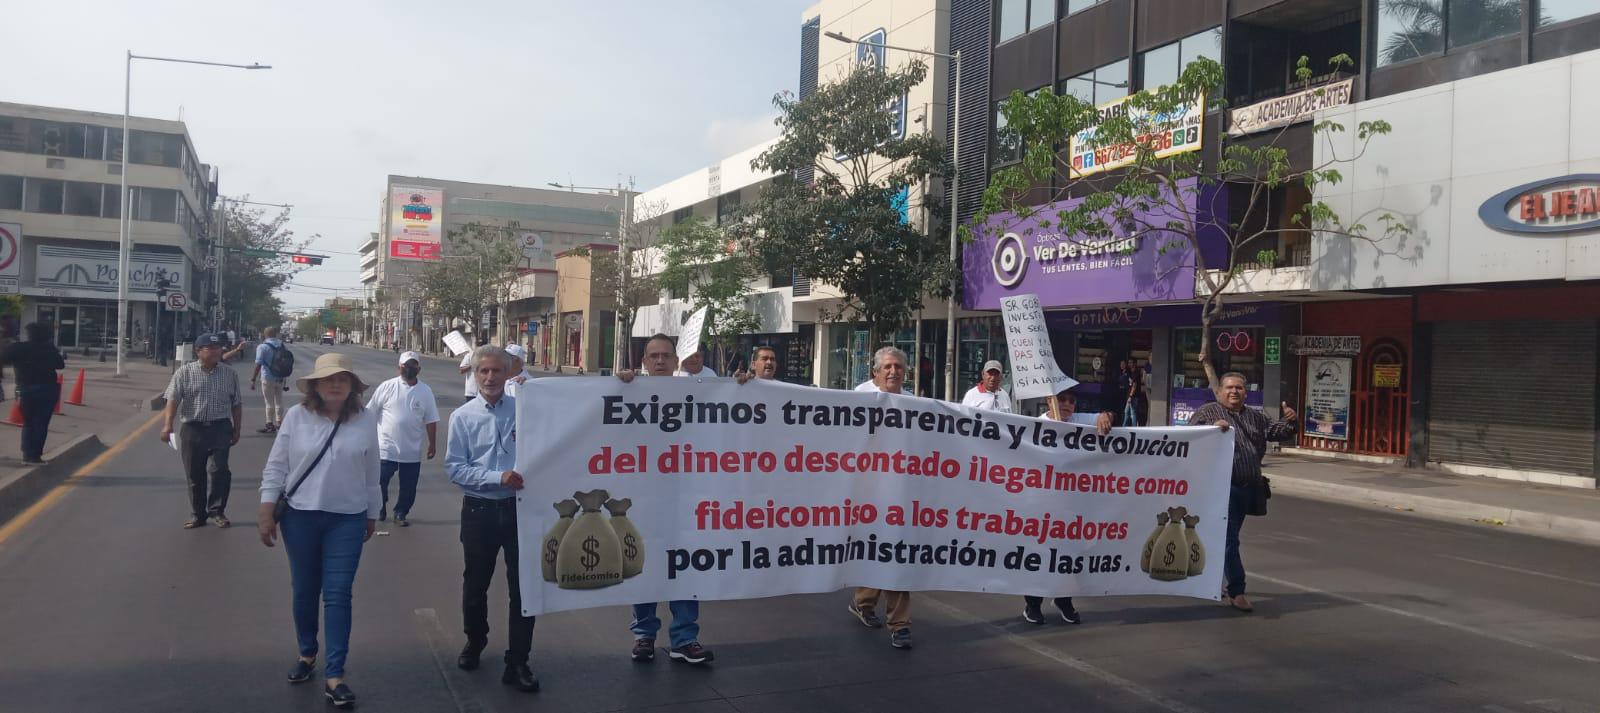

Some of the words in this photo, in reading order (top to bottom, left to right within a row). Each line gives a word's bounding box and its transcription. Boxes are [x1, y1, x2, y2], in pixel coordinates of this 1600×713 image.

[1257, 98, 1302, 123] ACADEMIA
[1320, 83, 1349, 109] ARTES
[1033, 245, 1056, 261] Ver
[1058, 242, 1077, 259] De
[1079, 231, 1137, 256] Verdad
[1042, 266, 1056, 274] TUS
[1089, 259, 1108, 269] BIEN
[1005, 300, 1018, 311] SR
[1009, 325, 1021, 334] EN
[1011, 338, 1033, 347] CUEN
[1304, 336, 1332, 349] ACADEMIA
[1343, 337, 1360, 350] ARTES
[1014, 349, 1033, 360] PAS
[601, 394, 767, 432] Exigimos
[782, 400, 1001, 441] transparencia
[1007, 423, 1027, 450] y
[1032, 421, 1058, 448] la
[588, 445, 647, 475] del
[657, 443, 777, 474] dinero
[784, 445, 960, 478] descontado
[969, 455, 1130, 495] ilegalmente
[1134, 476, 1189, 496] como
[695, 498, 878, 531] fideicomiso
[885, 504, 905, 527] a
[911, 500, 949, 528] los
[956, 506, 1129, 545] trabajadores
[666, 548, 734, 580] por
[741, 540, 771, 570] la
[777, 533, 997, 568] administración
[1003, 546, 1042, 572] de
[1049, 548, 1084, 575] las
[561, 571, 620, 583] Fideicomiso
